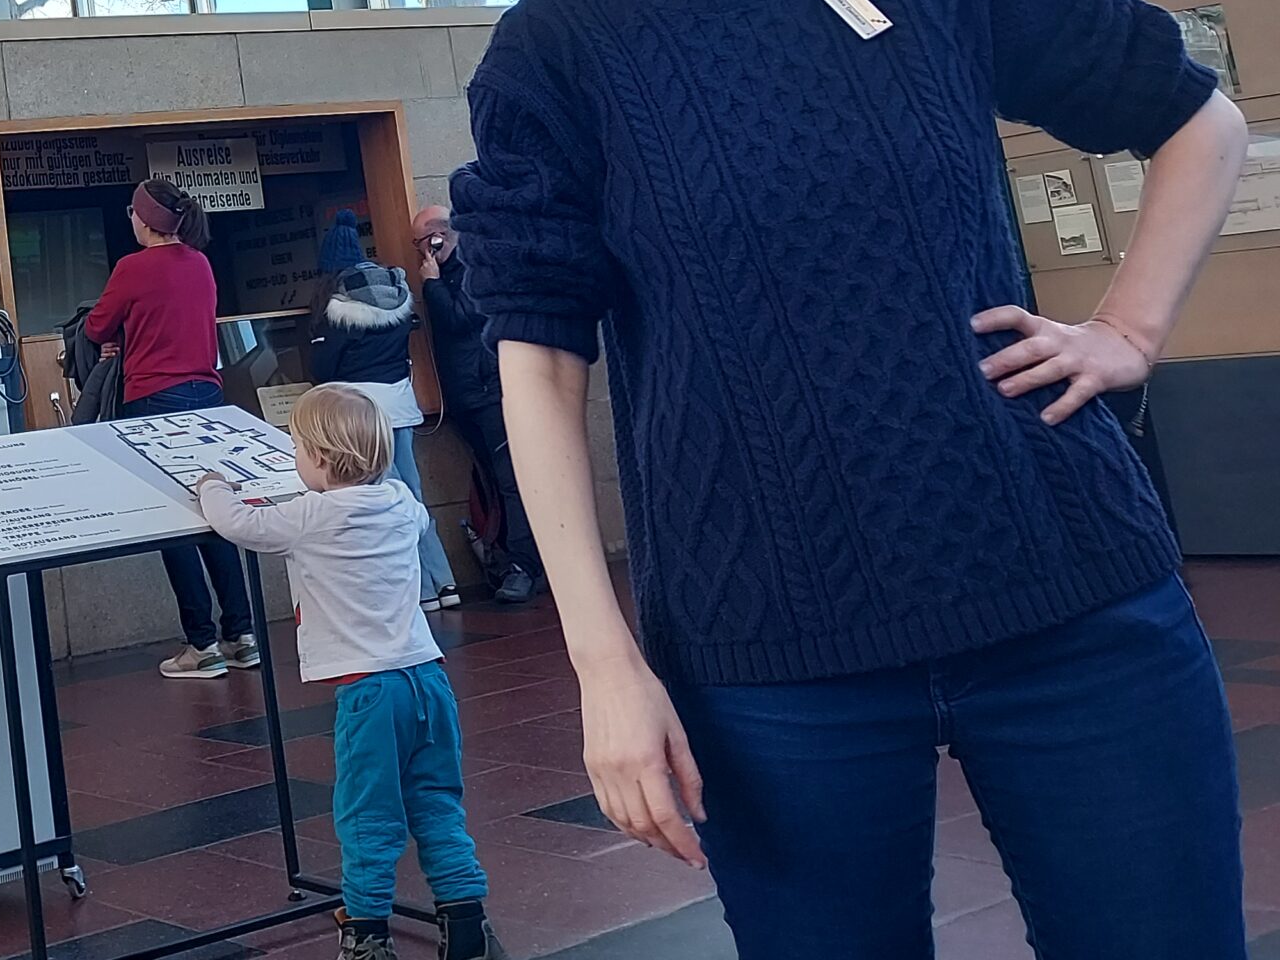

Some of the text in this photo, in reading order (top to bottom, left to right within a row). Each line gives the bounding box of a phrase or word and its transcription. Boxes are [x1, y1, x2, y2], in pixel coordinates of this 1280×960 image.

[3, 157, 20, 170] nur
[25, 152, 44, 170] mit
[47, 152, 91, 171] gültigen
[177, 144, 232, 167] Ausreise
[83, 166, 131, 186] gestattet
[175, 170, 237, 191] Diplomaten
[239, 168, 259, 184] und
[193, 190, 252, 209] treisende
